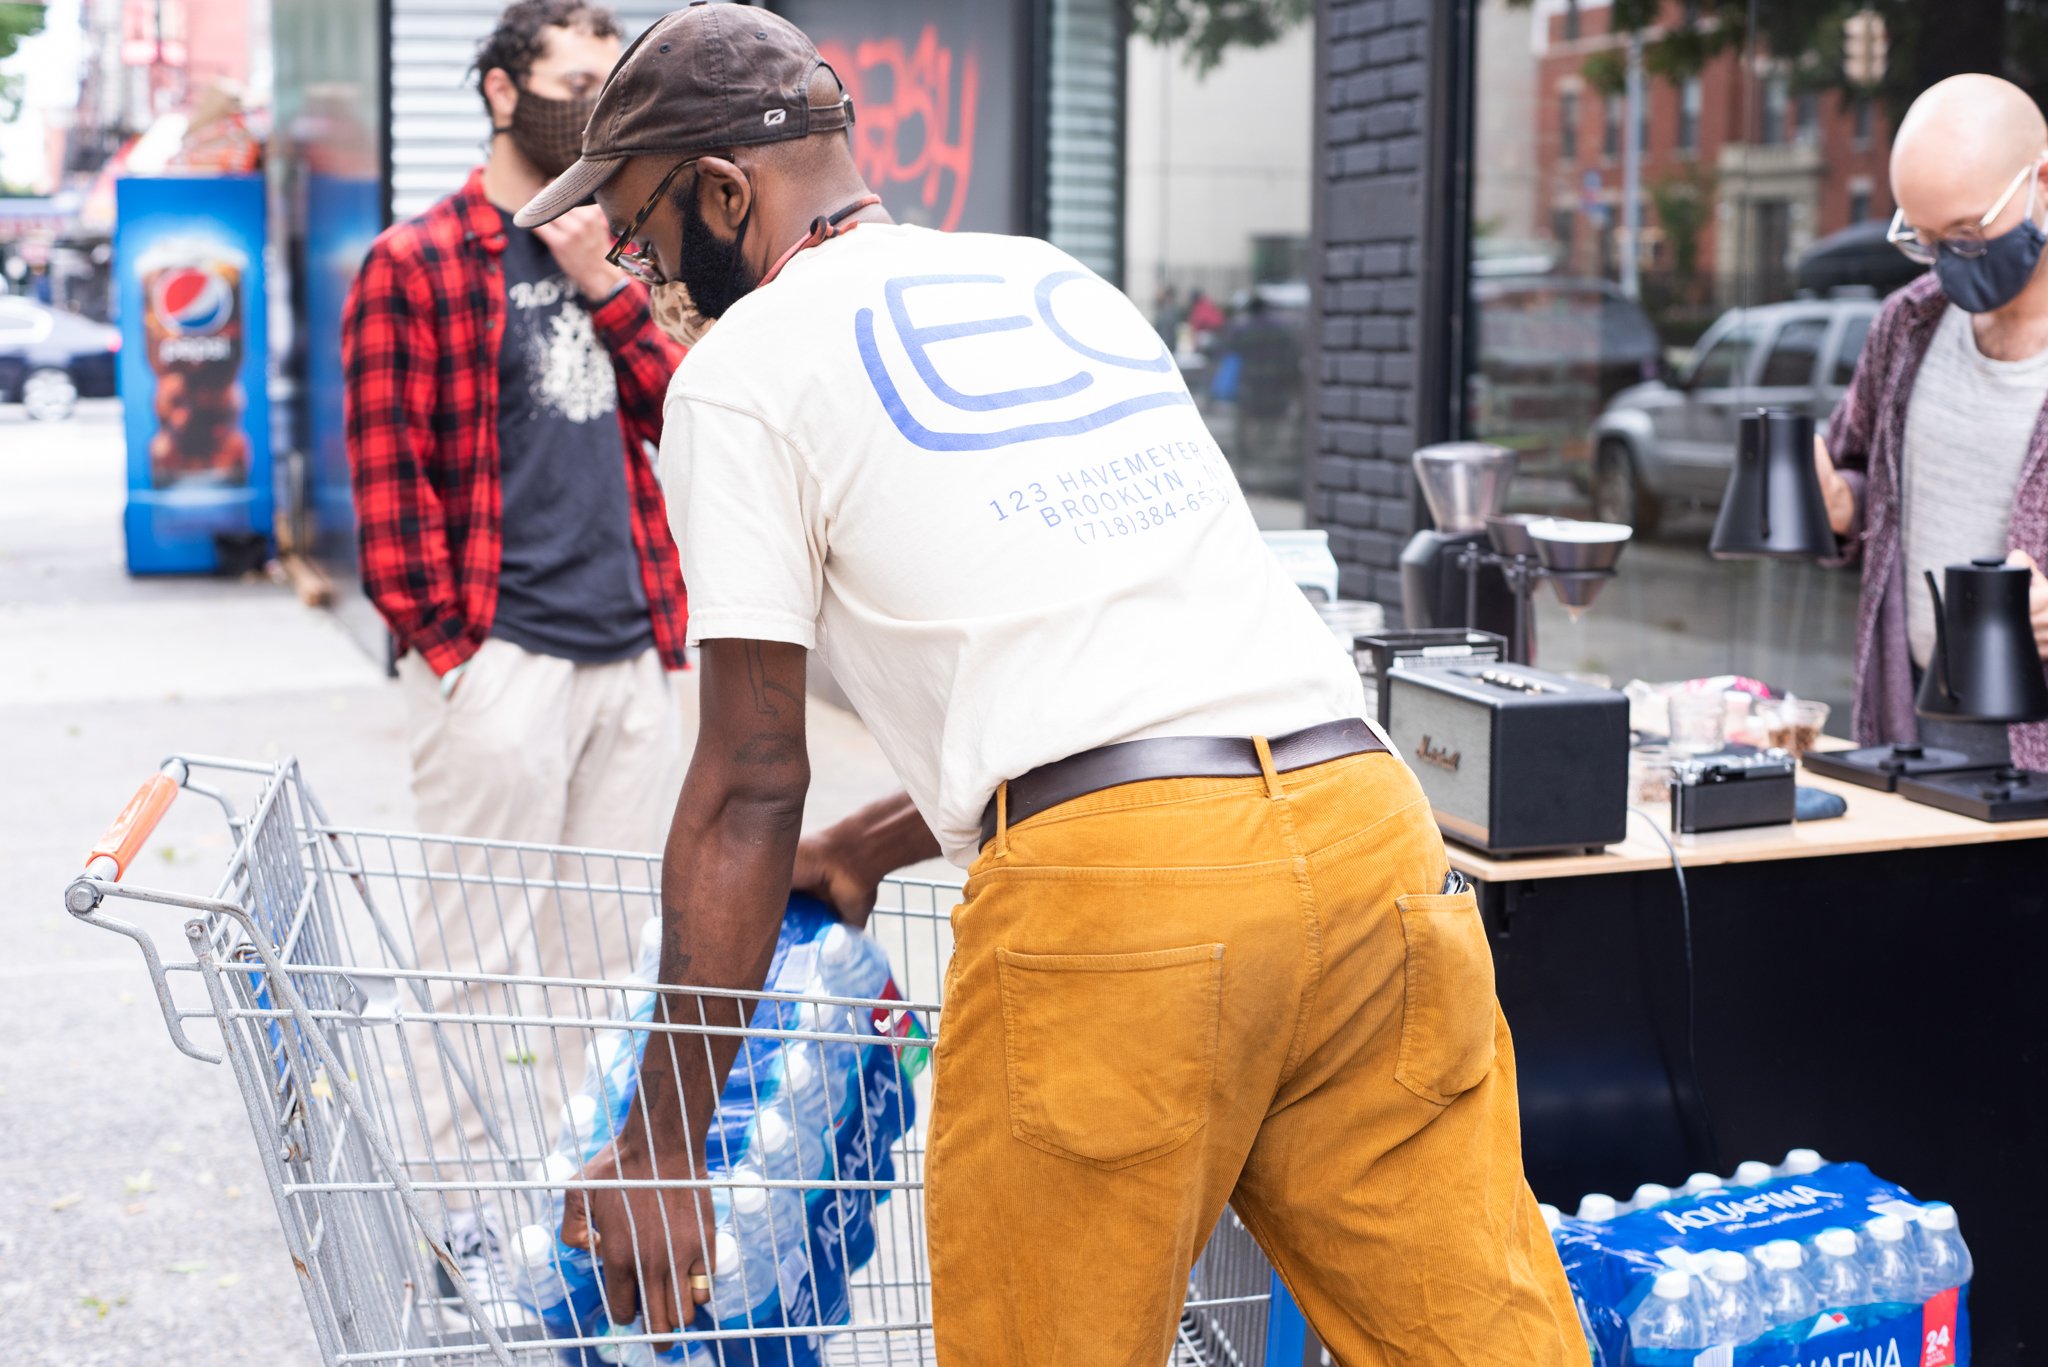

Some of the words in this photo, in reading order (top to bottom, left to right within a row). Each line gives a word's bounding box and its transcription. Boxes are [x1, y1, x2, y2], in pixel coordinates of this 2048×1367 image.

[989, 482, 1048, 521] 123
[1056, 441, 1204, 493] HAVEMEYER
[1039, 469, 1184, 527] BROOKLYN
[1663, 1185, 1844, 1234] AQUAFINA
[1759, 1337, 1903, 1367] FINA
[1926, 1325, 1950, 1353] 24
